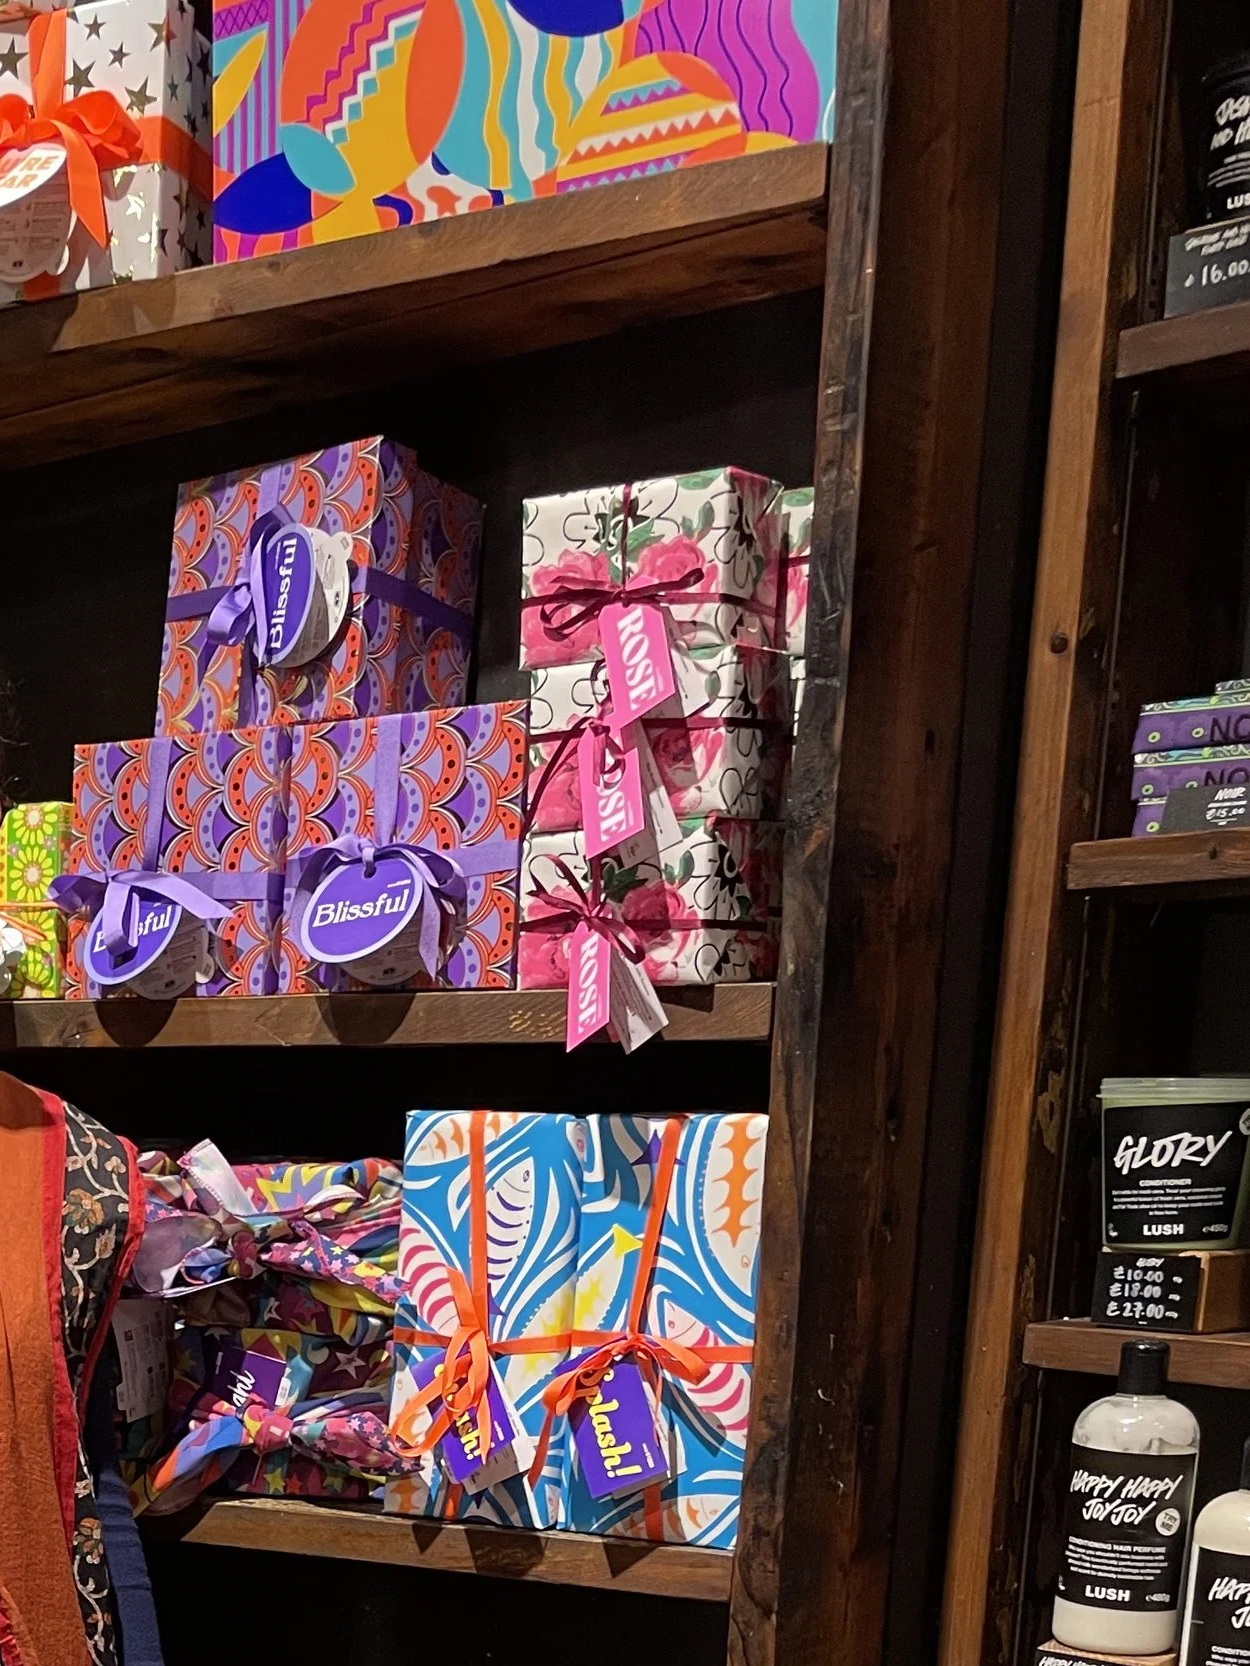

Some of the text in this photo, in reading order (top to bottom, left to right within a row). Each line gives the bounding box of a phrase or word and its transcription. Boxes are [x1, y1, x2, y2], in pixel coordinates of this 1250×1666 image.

[269, 537, 298, 649] Blissful
[617, 604, 659, 712] ROSE
[312, 888, 410, 928] Blissful
[577, 931, 599, 1035] ROSE
[1113, 1130, 1233, 1175] GLORY
[1142, 1223, 1185, 1236] LUSH
[1106, 1301, 1165, 1319] £27.00
[577, 1366, 643, 1479] Splash!
[1070, 1469, 1184, 1500] HAPPY HAPPY
[1082, 1498, 1157, 1525] JOY JOY
[1085, 1584, 1131, 1602] LUSH
[1207, 1576, 1250, 1605] HAP
